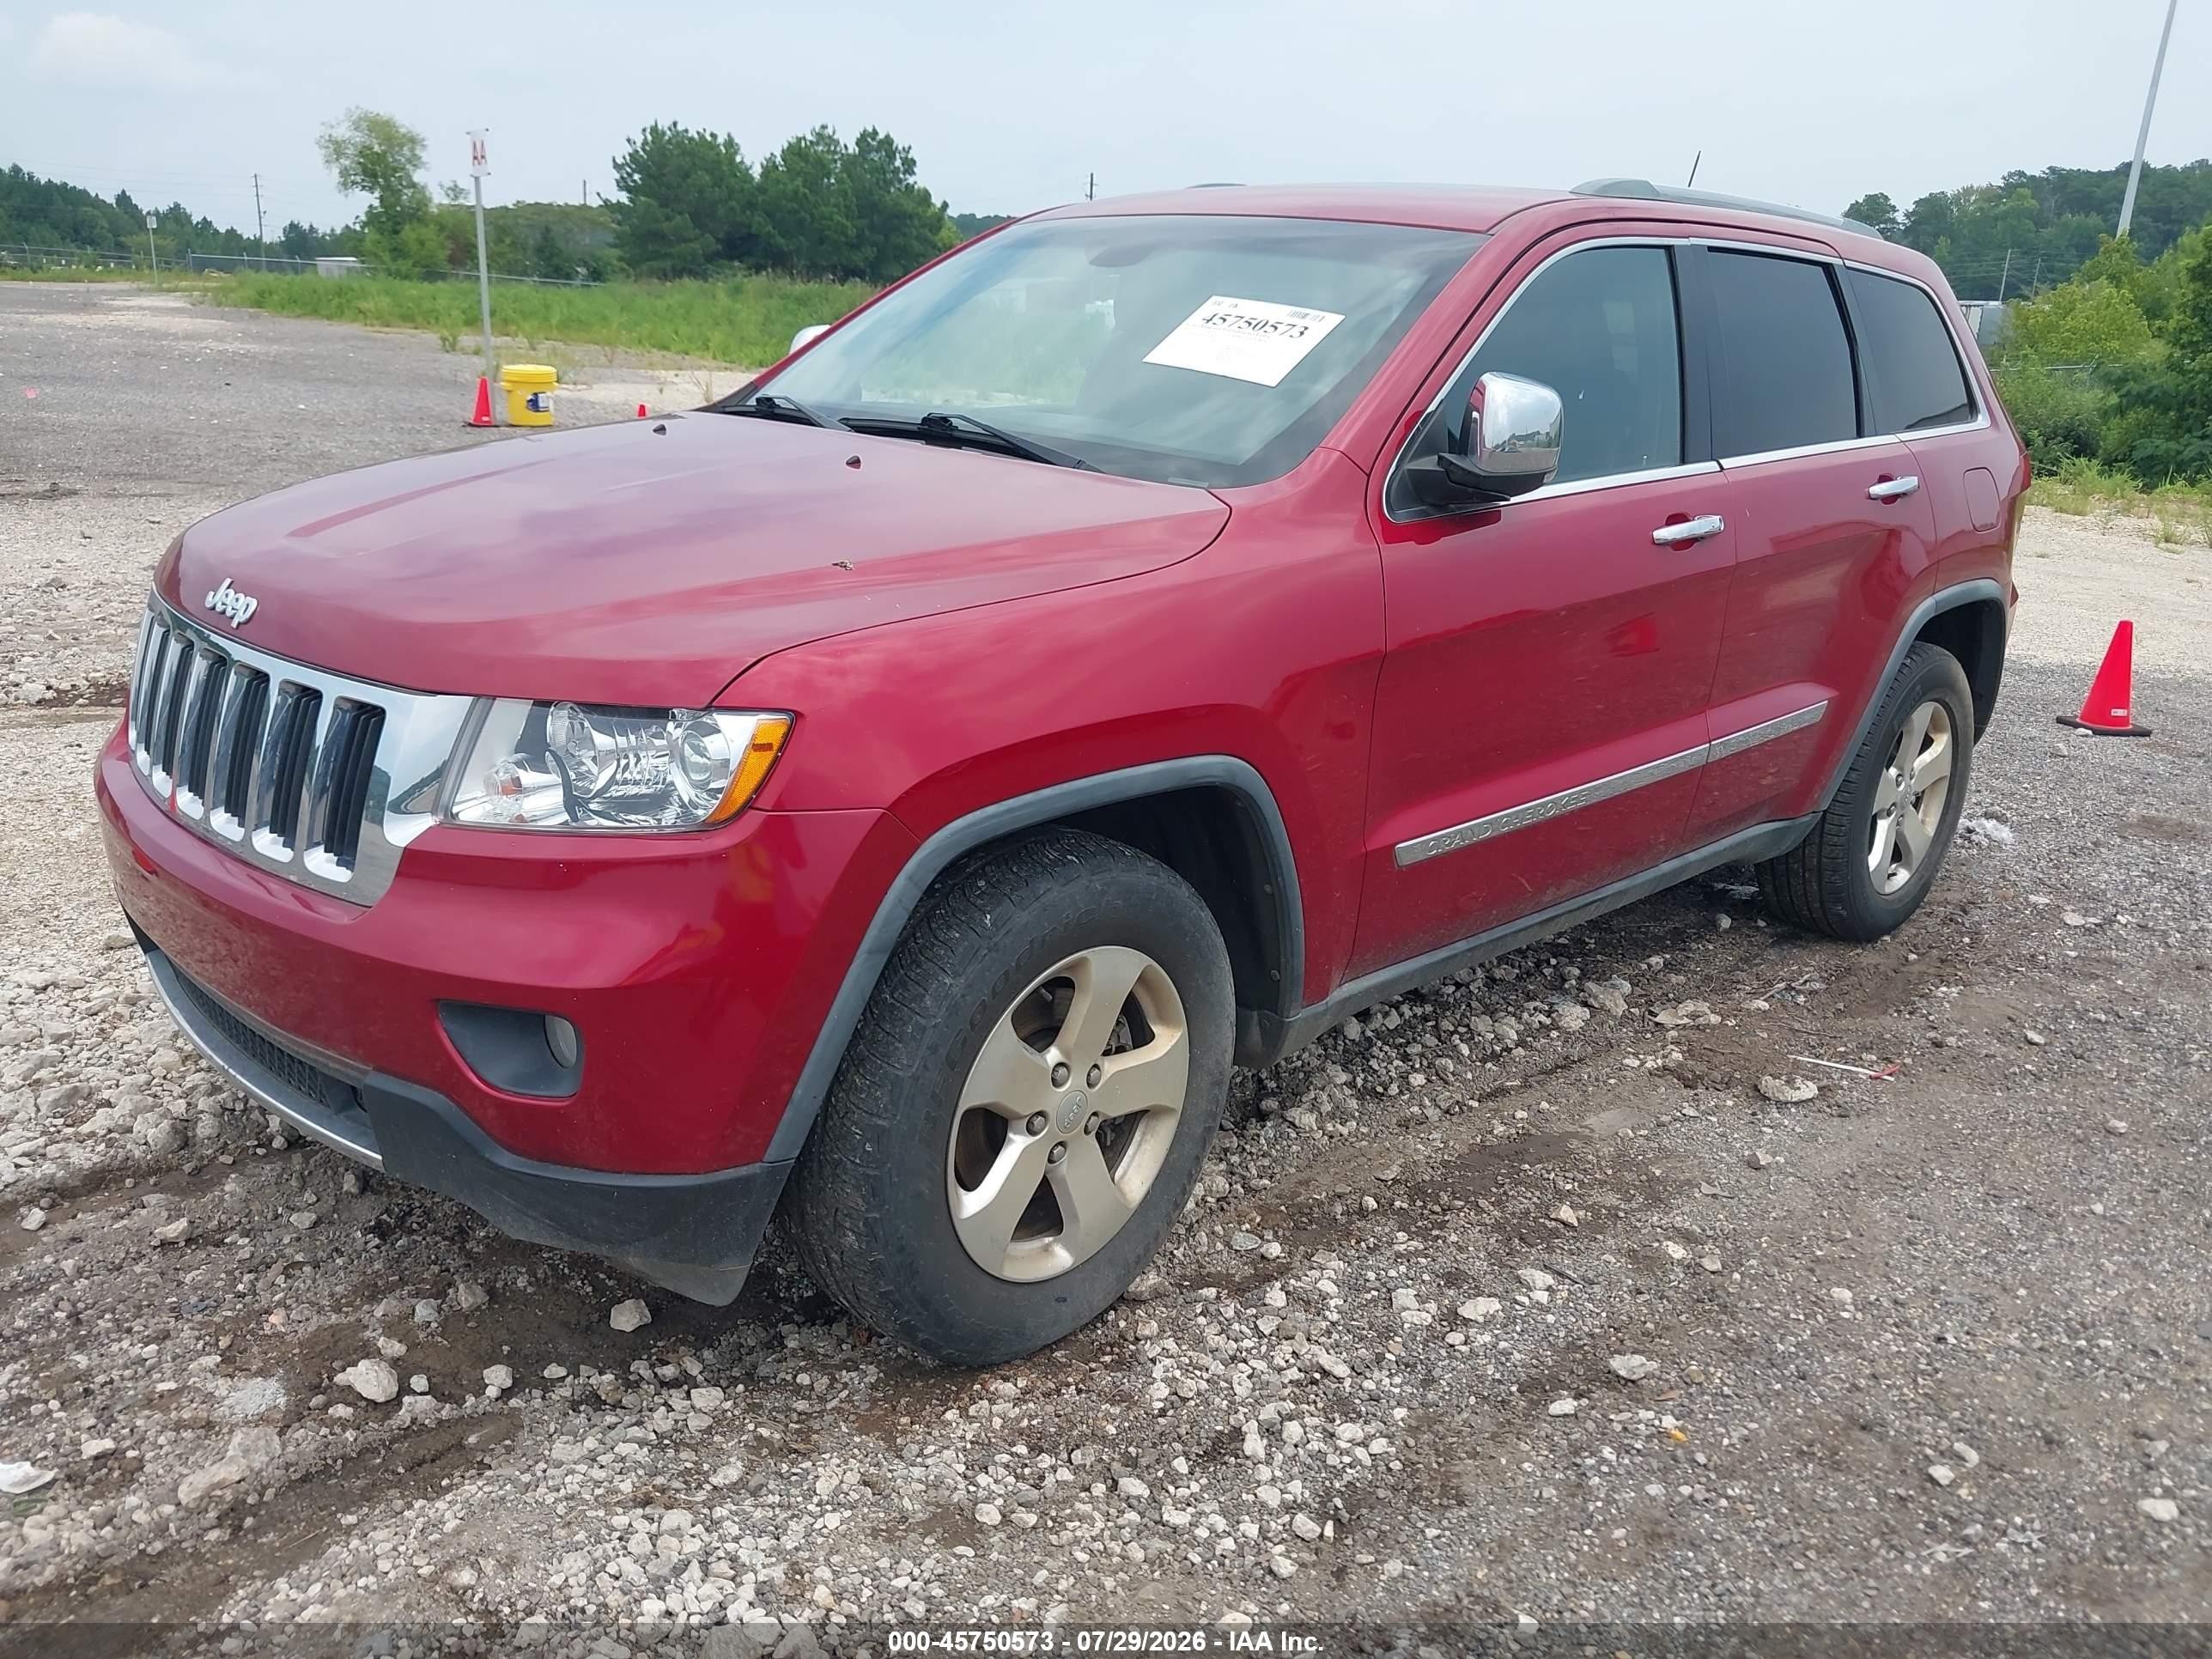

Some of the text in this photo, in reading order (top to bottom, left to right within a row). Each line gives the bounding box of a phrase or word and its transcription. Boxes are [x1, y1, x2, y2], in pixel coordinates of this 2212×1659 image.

[1201, 312, 1310, 339] 45750573
[204, 577, 258, 629] Jeep
[1426, 791, 1589, 855] GRAND CHEROKEE
